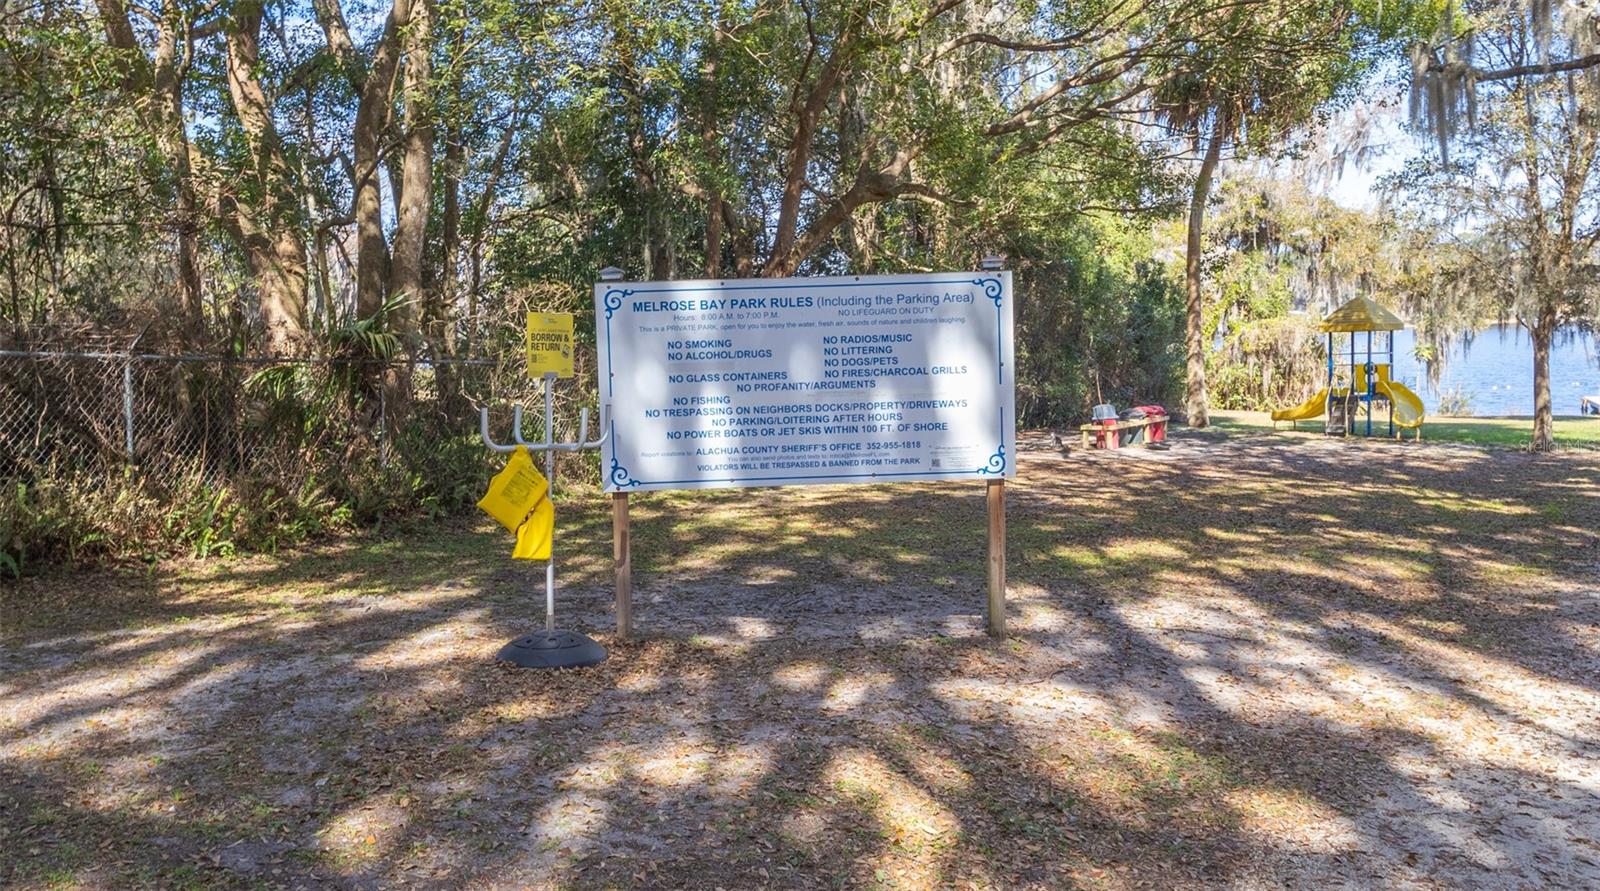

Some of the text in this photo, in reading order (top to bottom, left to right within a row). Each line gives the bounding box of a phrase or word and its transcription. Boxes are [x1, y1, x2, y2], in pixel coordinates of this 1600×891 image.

[633, 291, 975, 312] MELROSE BAY PARK RULES (Including the Parking Area)
[838, 306, 935, 317] NO LIFEGUARD ON DUTY
[531, 332, 569, 342] BORROW &
[823, 333, 913, 344] NO RADIOS/MUSIC
[531, 342, 560, 352] RETURN
[668, 339, 732, 349] NO SMOKING
[668, 350, 773, 360] NO ALCOHOL/DRUGS
[824, 345, 893, 356] NO LITTERING
[824, 357, 898, 367] NO DOGS/PETS
[669, 372, 788, 383] NO GLASS CONTAINERS
[825, 366, 968, 378] NO FIRES/CHARCOAL GRILLS
[737, 380, 876, 392] NO PROFANITY/ARGUMENTS
[673, 396, 731, 406] NO FISHING
[645, 400, 968, 418] NO TRESPASSING ON NEIGHBORS DOCKS/PROPERTY/DRIVEWAYS
[712, 413, 903, 427] NO PARKING/LOITERING AFTER HOURS
[667, 422, 949, 440] NO POWER BOATS OR JET SKIS WITHIN 100 FT. OF SHORE
[696, 440, 920, 456] ALACHUA COUNTY SHERIFF'S OFFICE 352-955-1818
[697, 463, 739, 472] VIOLATORS
[760, 462, 770, 470] BE
[772, 461, 820, 469] TRESPASSED
[900, 457, 920, 465] PARK
